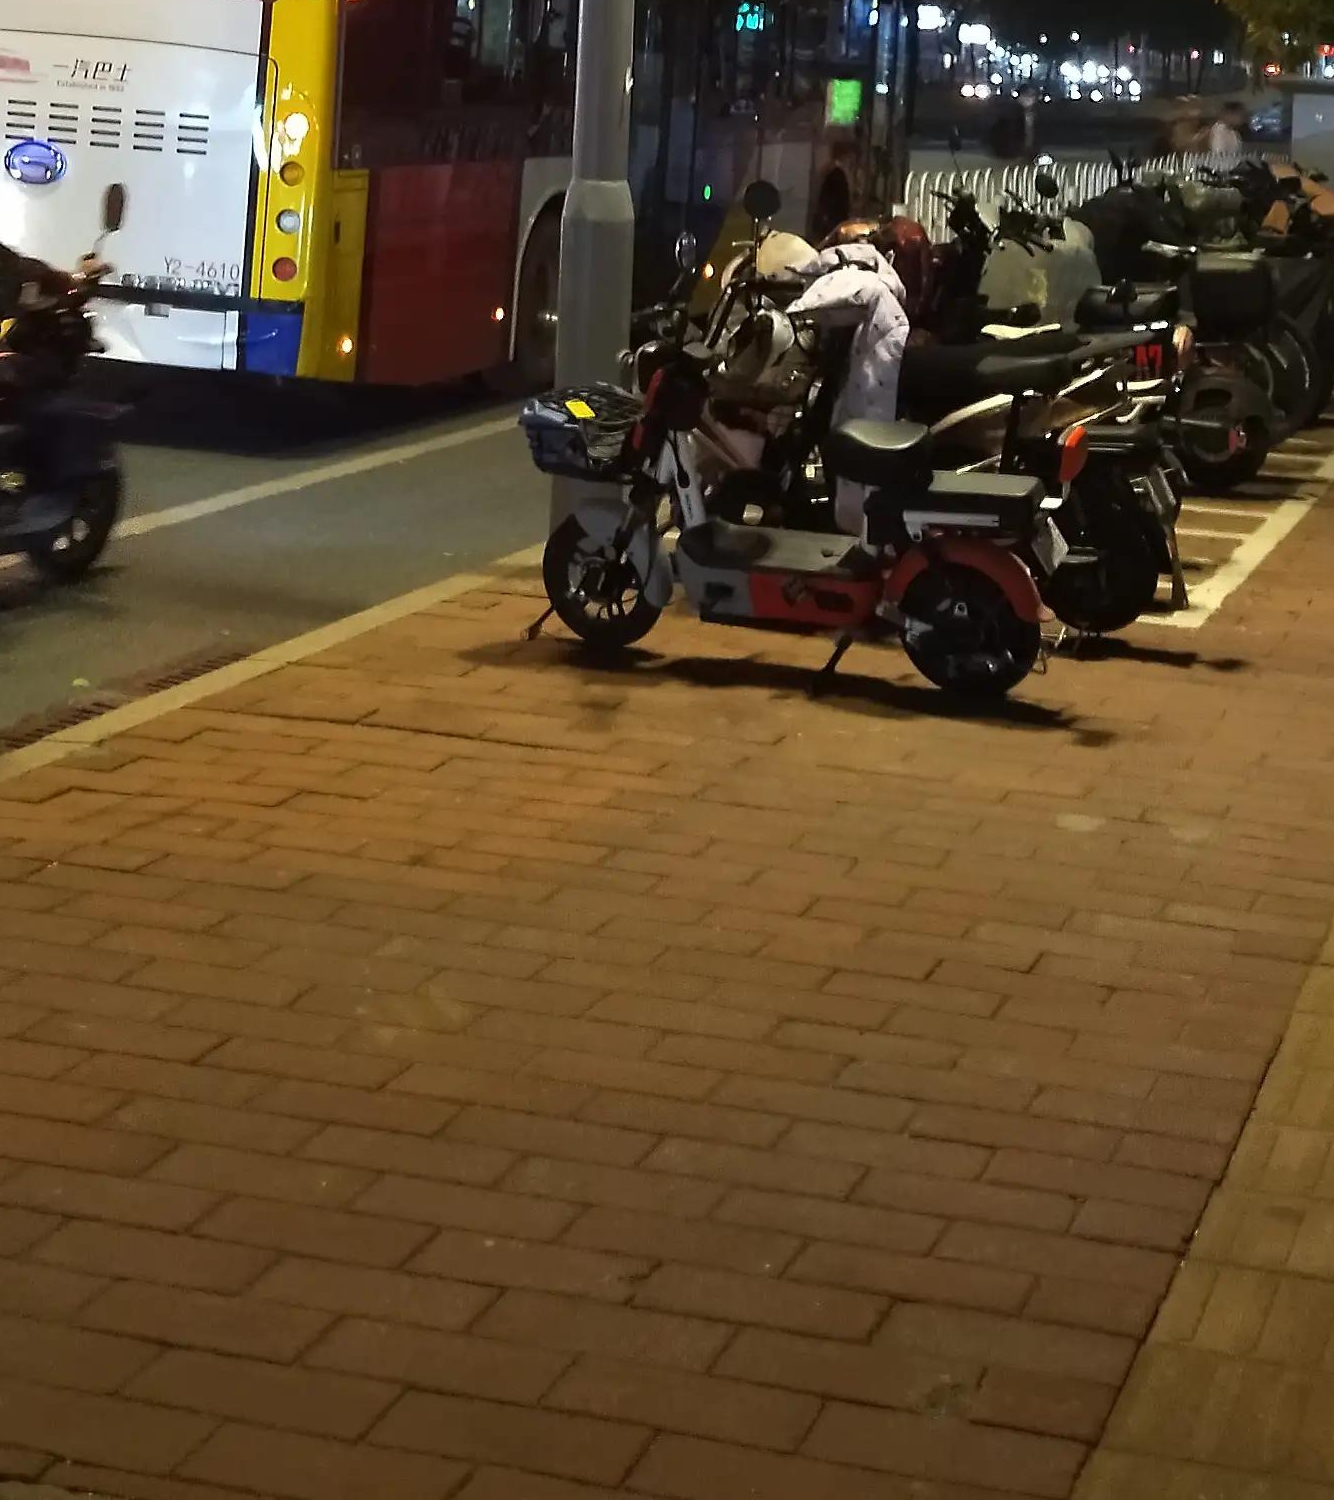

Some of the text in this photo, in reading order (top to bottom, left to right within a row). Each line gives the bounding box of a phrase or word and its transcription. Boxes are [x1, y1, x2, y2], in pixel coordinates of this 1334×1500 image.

[52, 57, 131, 82] 一汽巴士
[164, 255, 240, 281] Y2-4610
